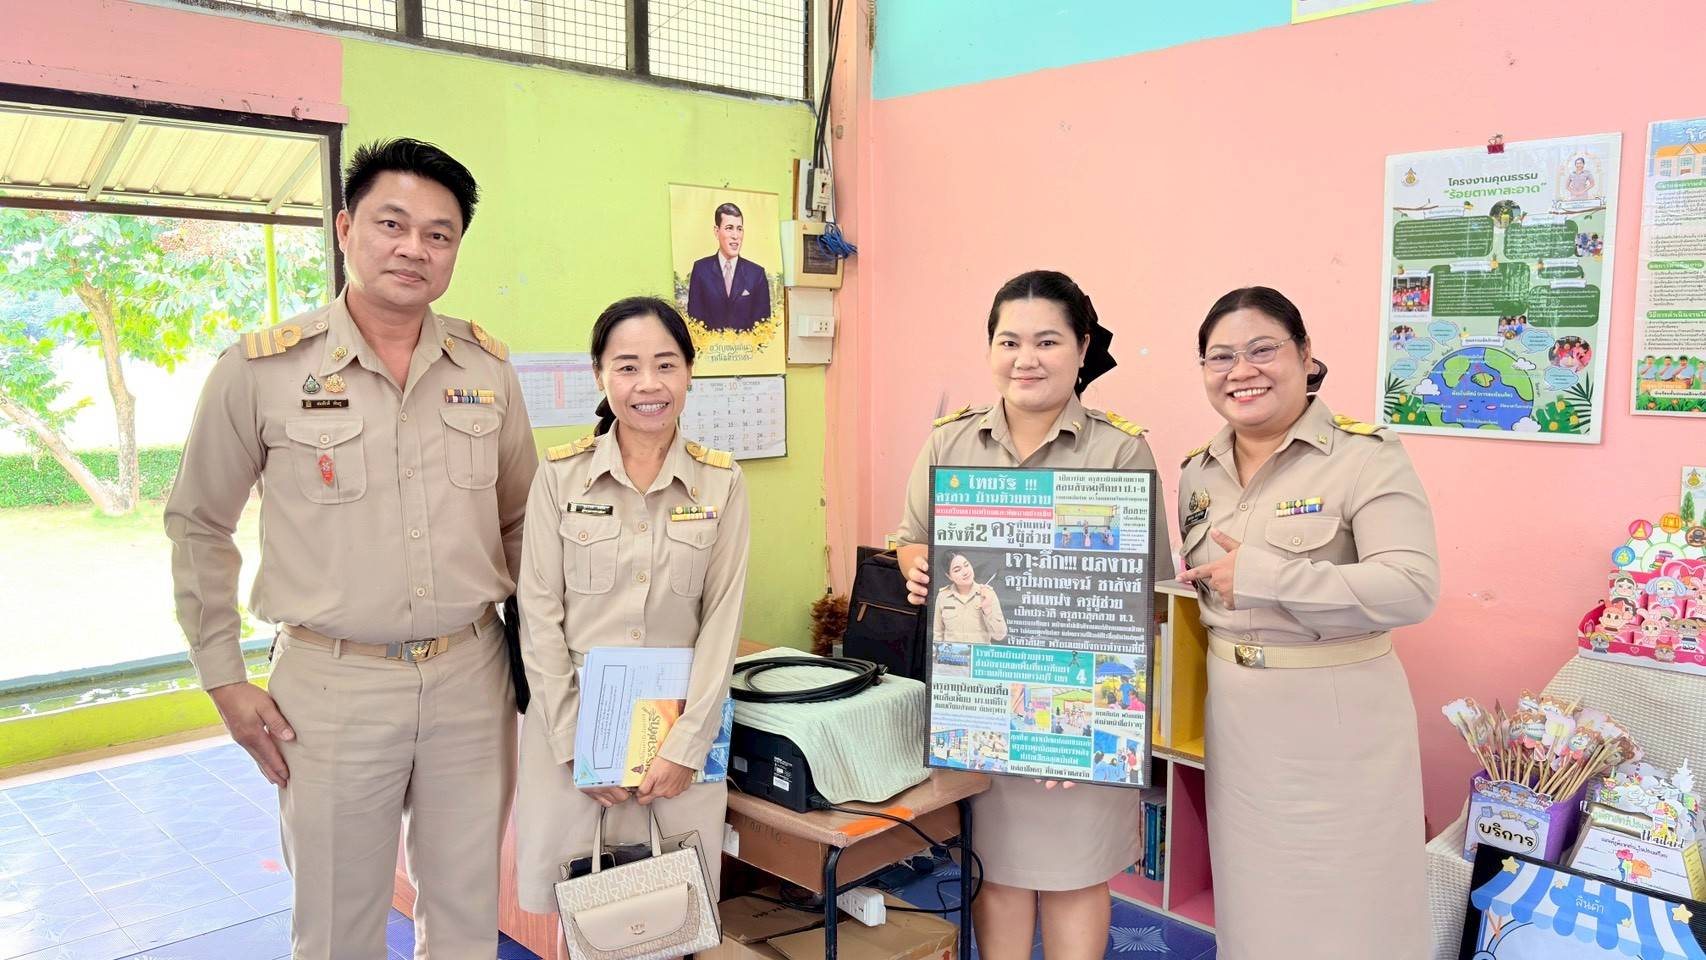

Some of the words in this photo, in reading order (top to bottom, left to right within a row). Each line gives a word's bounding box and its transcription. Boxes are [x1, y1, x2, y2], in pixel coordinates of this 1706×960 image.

[1447, 172, 1539, 187] โครงงานคุณธรรม
[968, 473, 1017, 490] ไทยรัฐ
[936, 491, 970, 506] ครูสาว
[991, 521, 1016, 544] ครู
[1016, 520, 1052, 530] ตำแหน่ง
[1016, 530, 1051, 548] ผู้ช่วย
[1005, 548, 1077, 571] เจาะลึก!!!
[1081, 556, 1144, 574] ผลงาน
[1021, 592, 1071, 607] ตำแหน่ง
[1076, 594, 1123, 613] ครูผู้ช่วย
[1075, 668, 1088, 684] 4
[1478, 821, 1534, 848] บริการ
[1574, 895, 1605, 914] สินค้า
